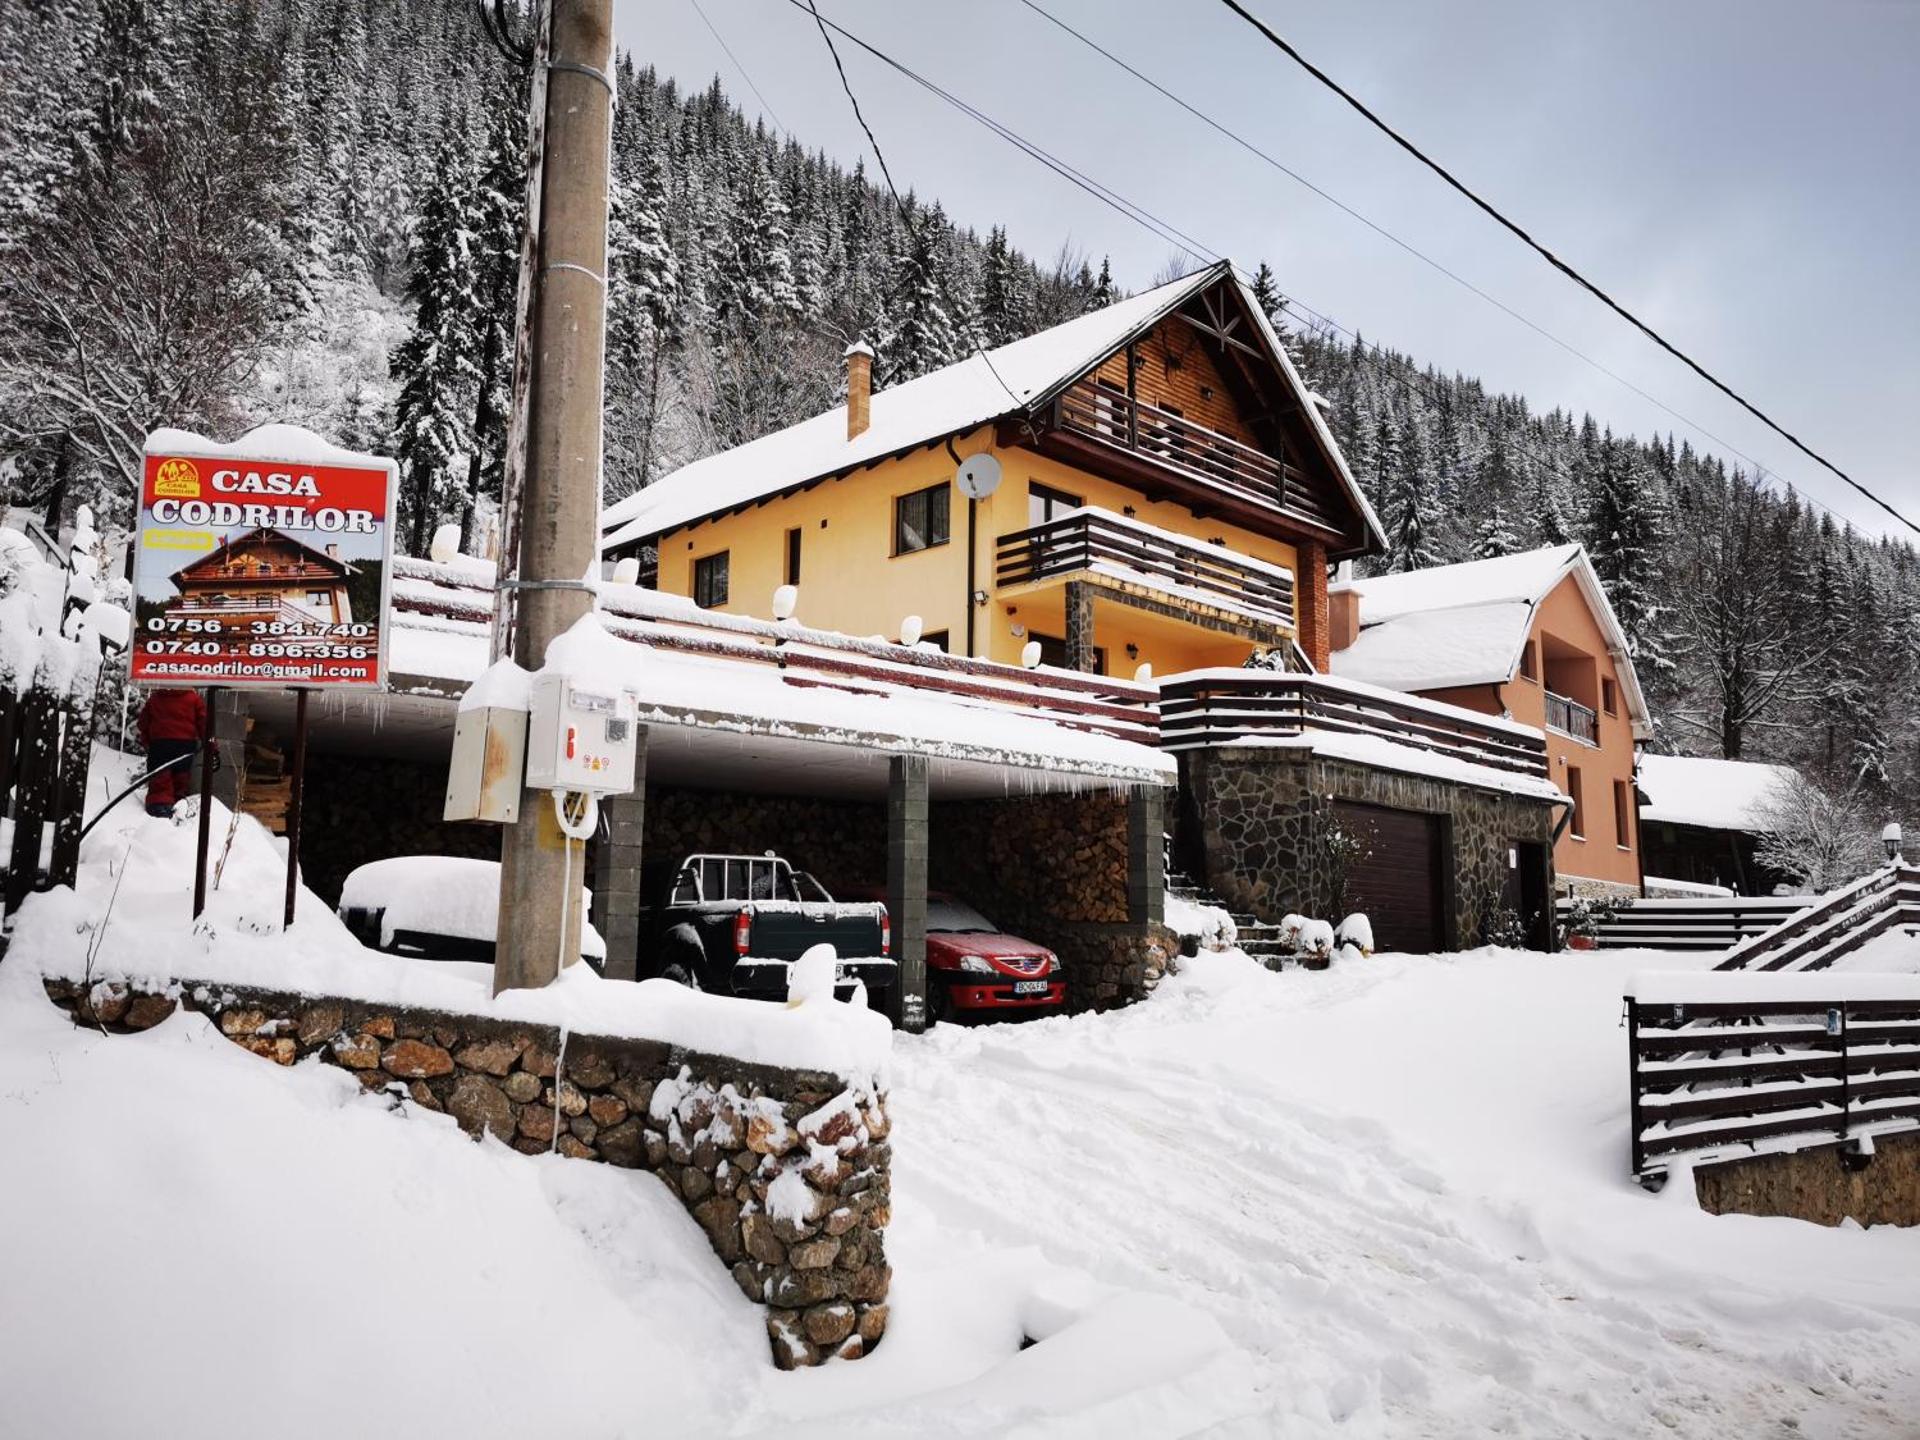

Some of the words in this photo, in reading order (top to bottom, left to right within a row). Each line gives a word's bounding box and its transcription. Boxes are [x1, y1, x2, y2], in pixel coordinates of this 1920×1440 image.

[212, 470, 321, 497] CASA
[151, 499, 376, 534] CODRILOR
[148, 617, 222, 634] 0756
[250, 621, 369, 637] 384.740
[146, 640, 221, 656] 0740
[248, 643, 368, 659] 896.356
[145, 661, 367, 678] casacodrilor@gmail.com
